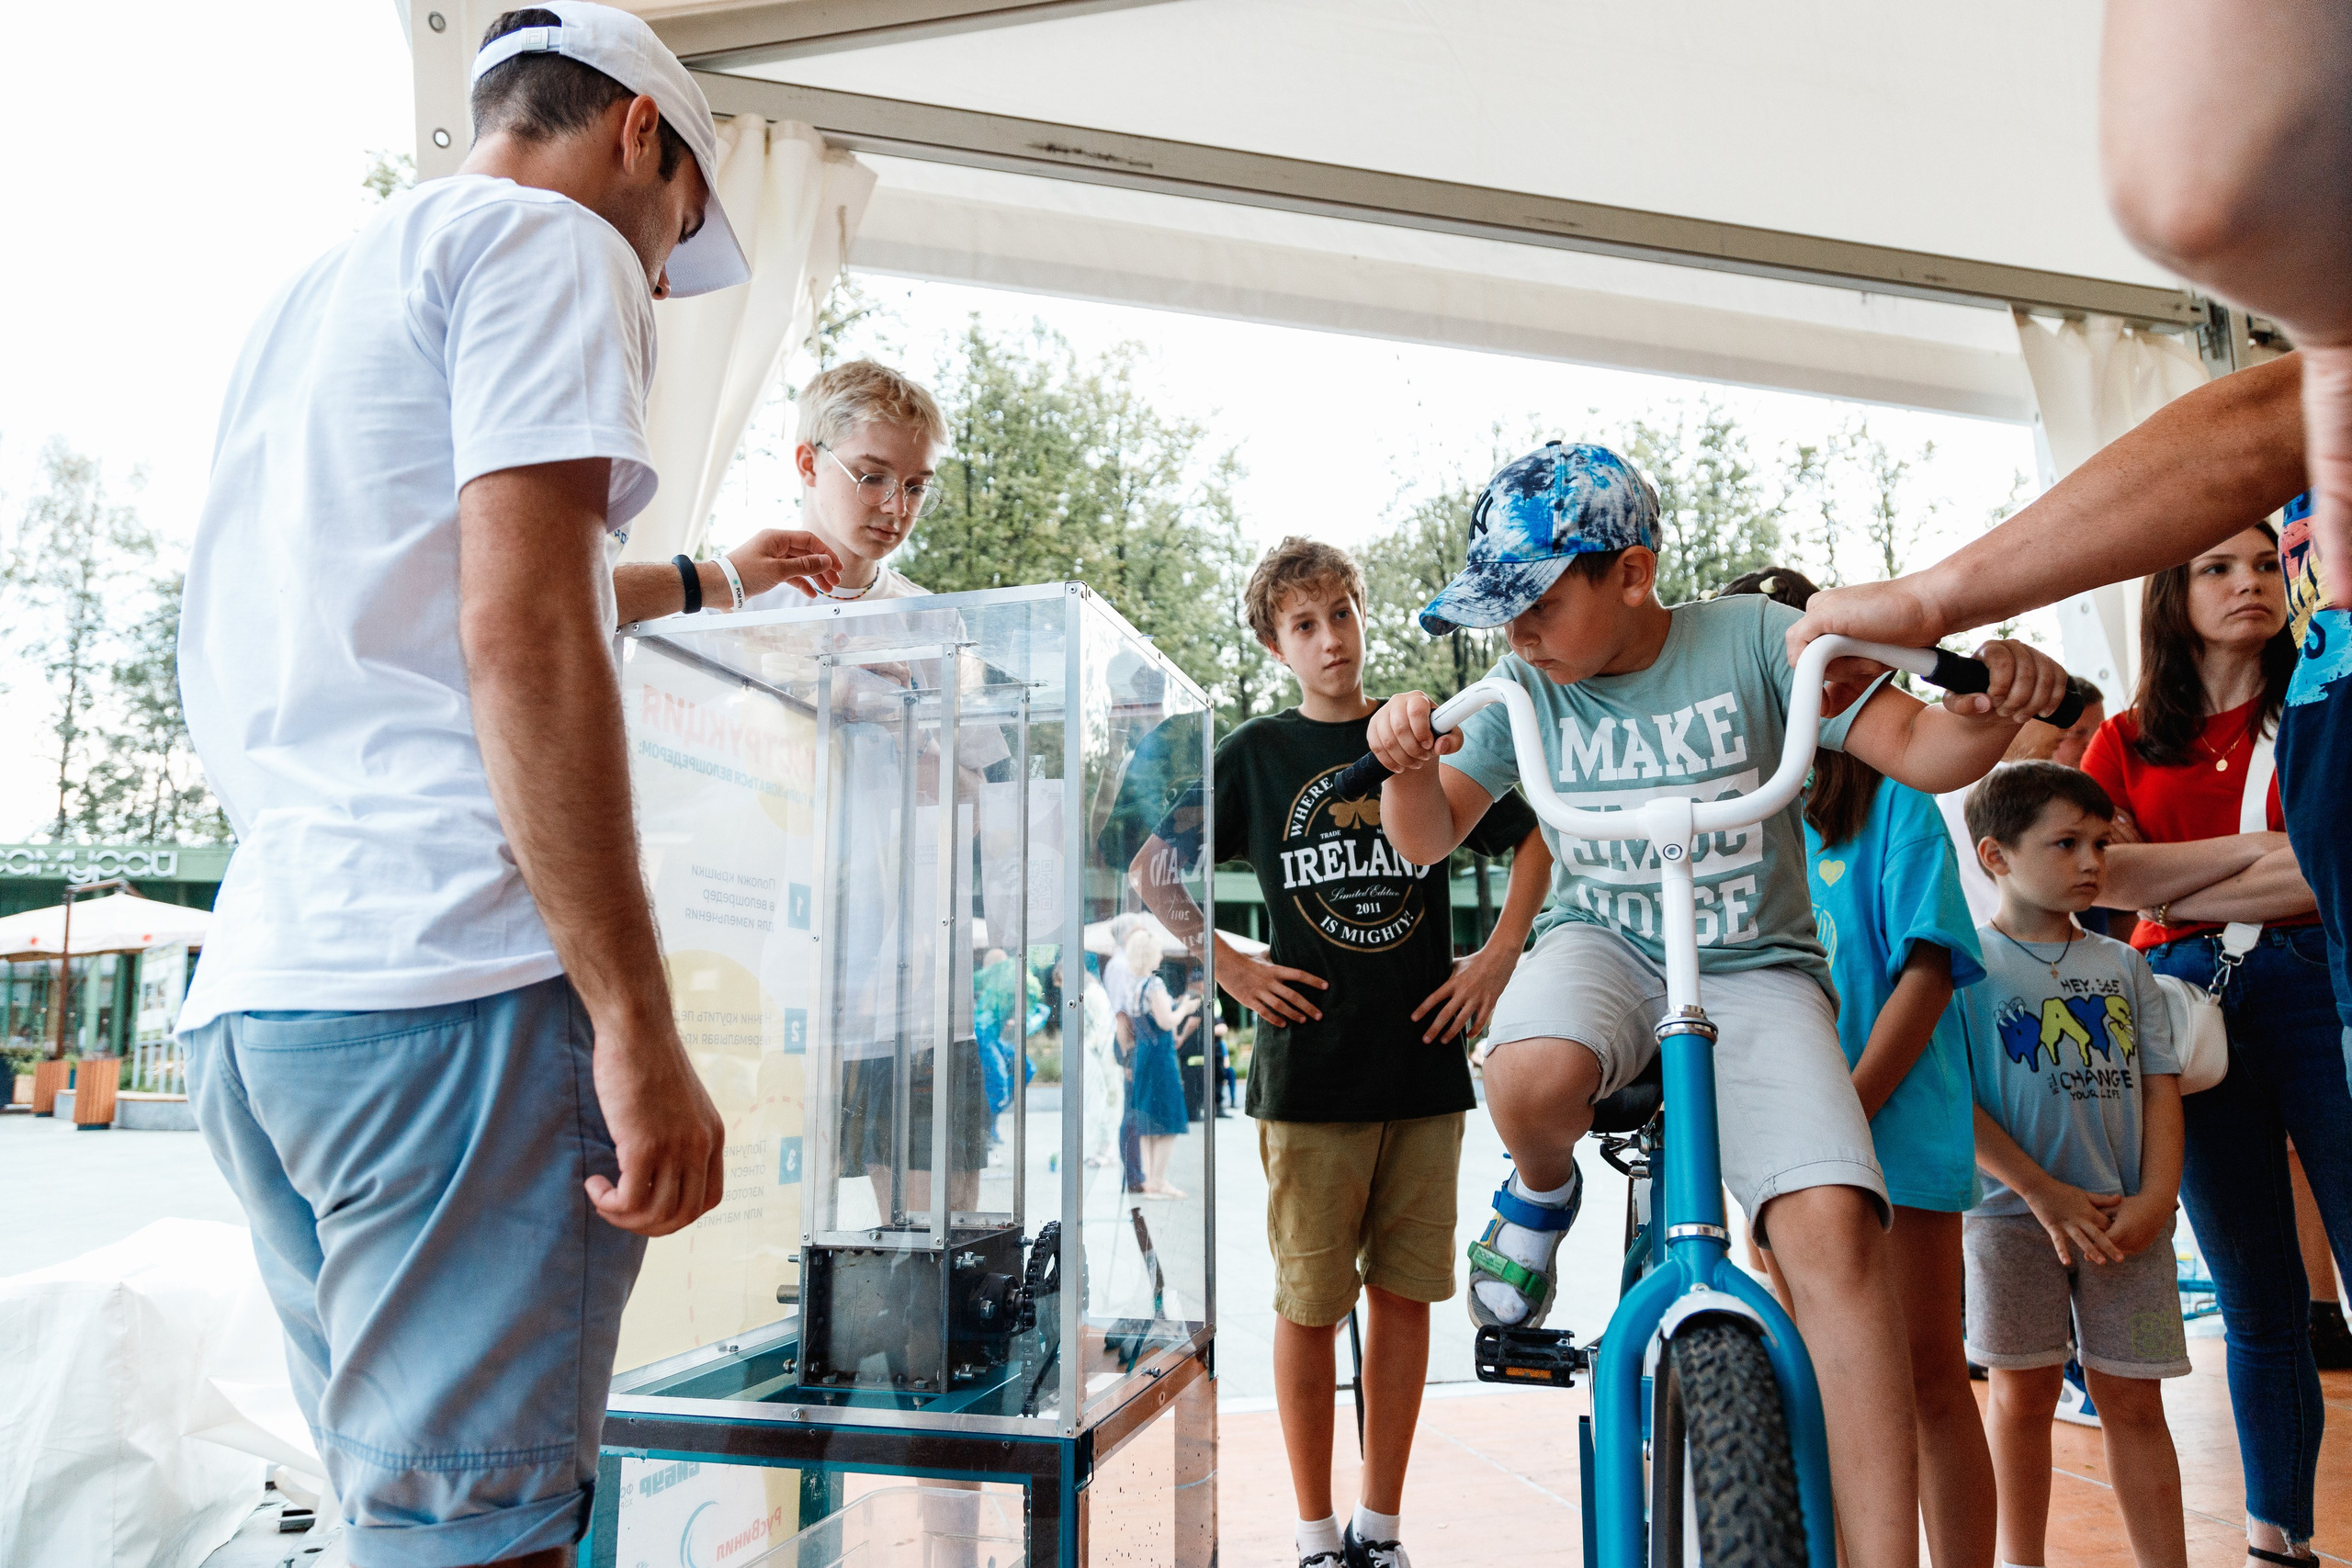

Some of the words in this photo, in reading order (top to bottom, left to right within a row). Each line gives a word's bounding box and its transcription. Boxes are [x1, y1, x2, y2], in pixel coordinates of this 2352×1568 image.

[1558, 692, 1747, 783] MAKE
[1290, 777, 1334, 837] WHERE
[1320, 829, 1341, 840] TRADE
[1280, 838, 1430, 889] IRELAN
[1329, 886, 1368, 902] Limited
[1369, 885, 1400, 897] Edition
[1355, 902, 1381, 915] 2011
[1319, 915, 1339, 933] IS
[1340, 909, 1415, 943] MIGHTY!
[2060, 1069, 2133, 1090] CHANGE
[2070, 1089, 2098, 1100] YOUR
